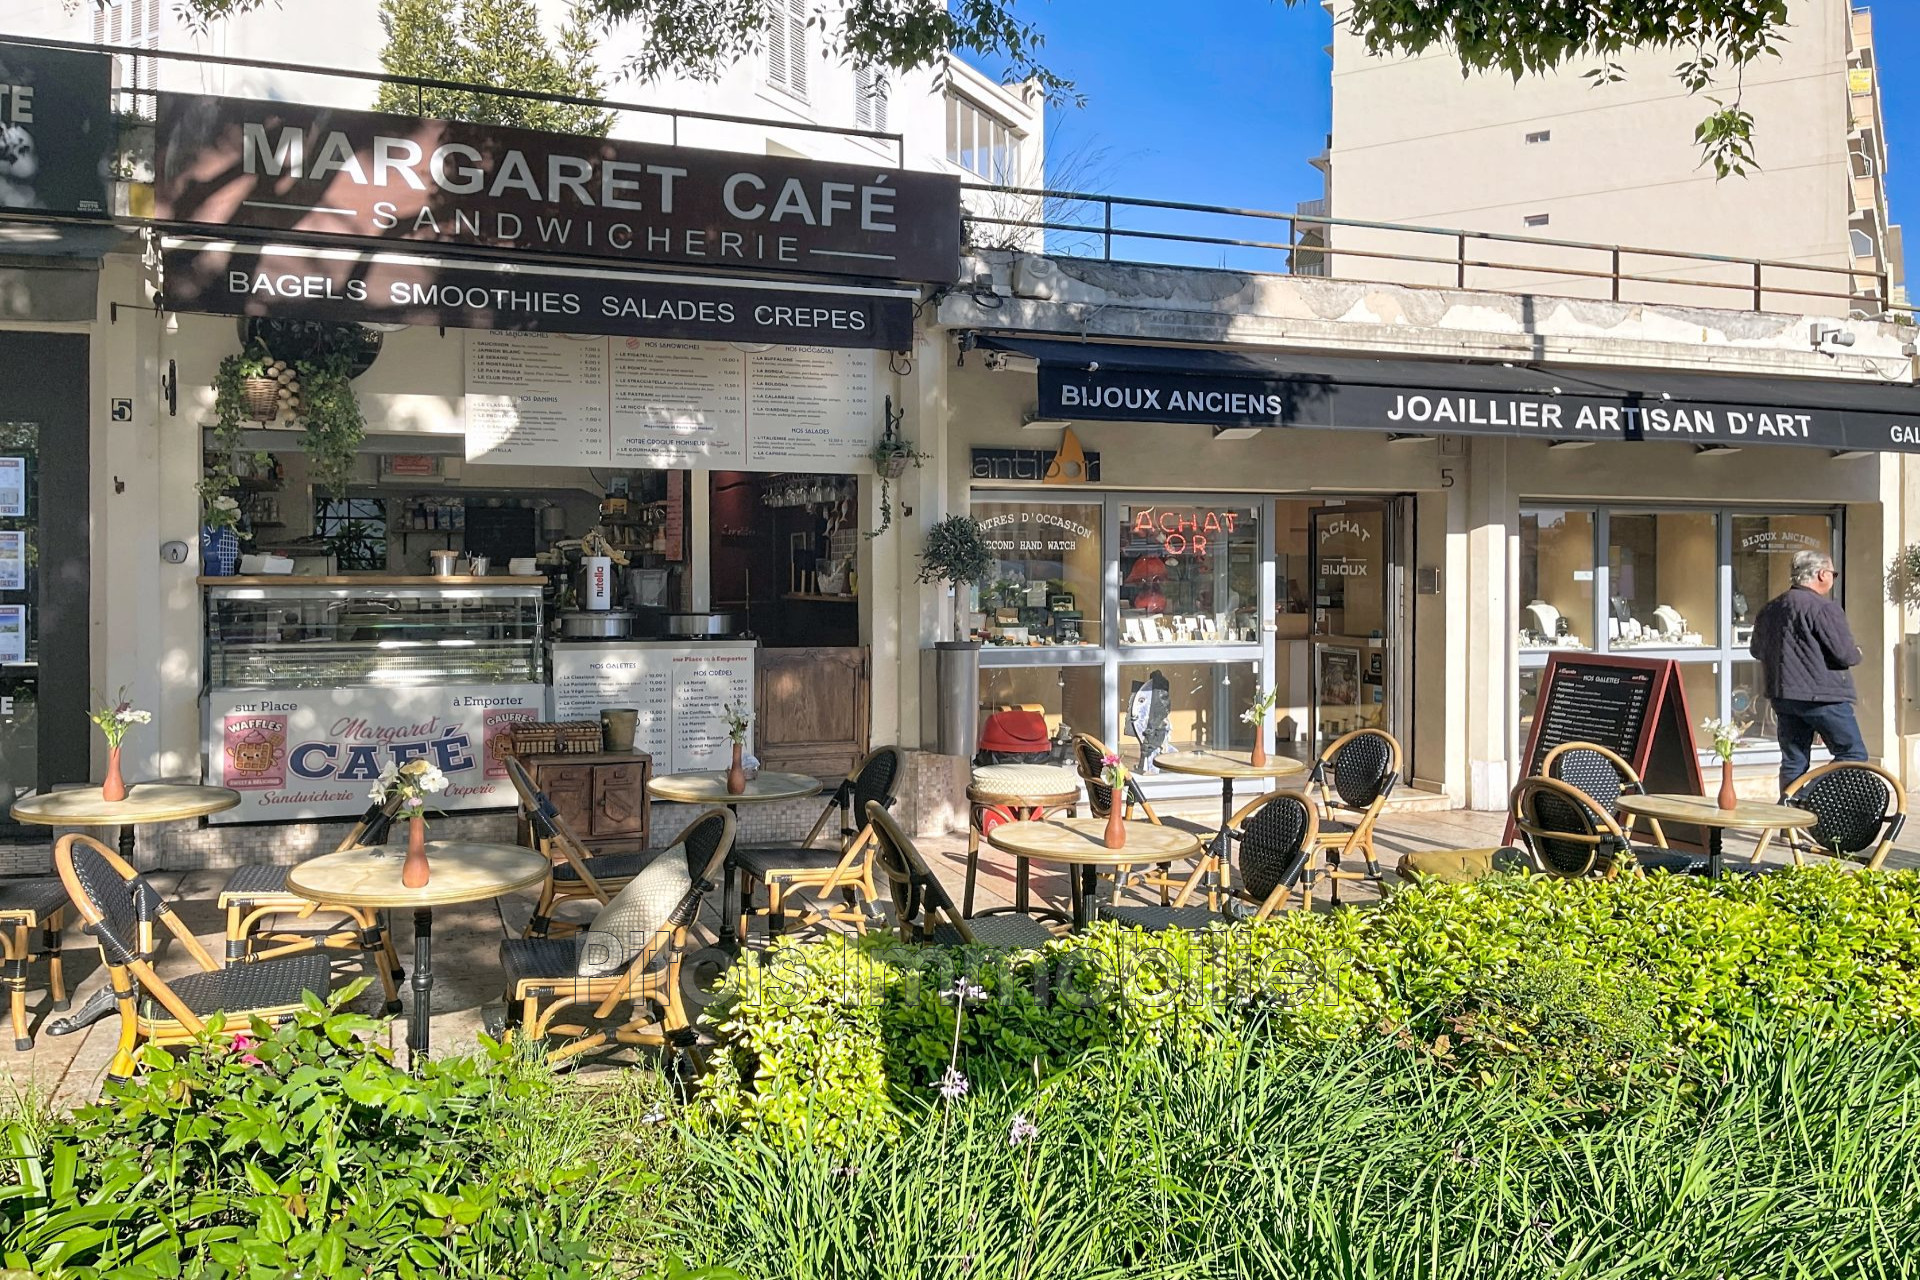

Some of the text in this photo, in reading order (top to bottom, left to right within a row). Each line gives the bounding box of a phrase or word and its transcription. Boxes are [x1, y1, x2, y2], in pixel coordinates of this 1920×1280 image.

[243, 122, 896, 232] MARGARET CAFÉ
[372, 202, 798, 262] SANDWICHERIE
[229, 271, 865, 331] BAGELS SMOOTHIES SALADES CREPES
[113, 399, 131, 421] 5
[1061, 385, 1282, 416] BIJOUX ANCIENS
[1387, 395, 1811, 438] JOAILLIER ARTISAN D'ART
[1441, 468, 1454, 488] 5
[978, 512, 1092, 539] NTRES D'OCCASION
[1134, 510, 1238, 533] ACHAT
[1320, 520, 1371, 545] ACHAT
[984, 541, 1076, 550] ECOND HAND WATCH
[1165, 533, 1207, 555] OR
[1742, 532, 1777, 548] BIJOUX
[1321, 564, 1367, 576] BIJOUX
[594, 566, 604, 598] nutella
[235, 701, 298, 712] sur Place
[453, 696, 523, 708] à Emporter
[228, 719, 283, 734] WAFFLES
[330, 716, 440, 746] Margaret
[486, 713, 535, 727] GAUFRES
[288, 723, 476, 782] CAFÉ
[258, 790, 355, 806] Sandwicherie
